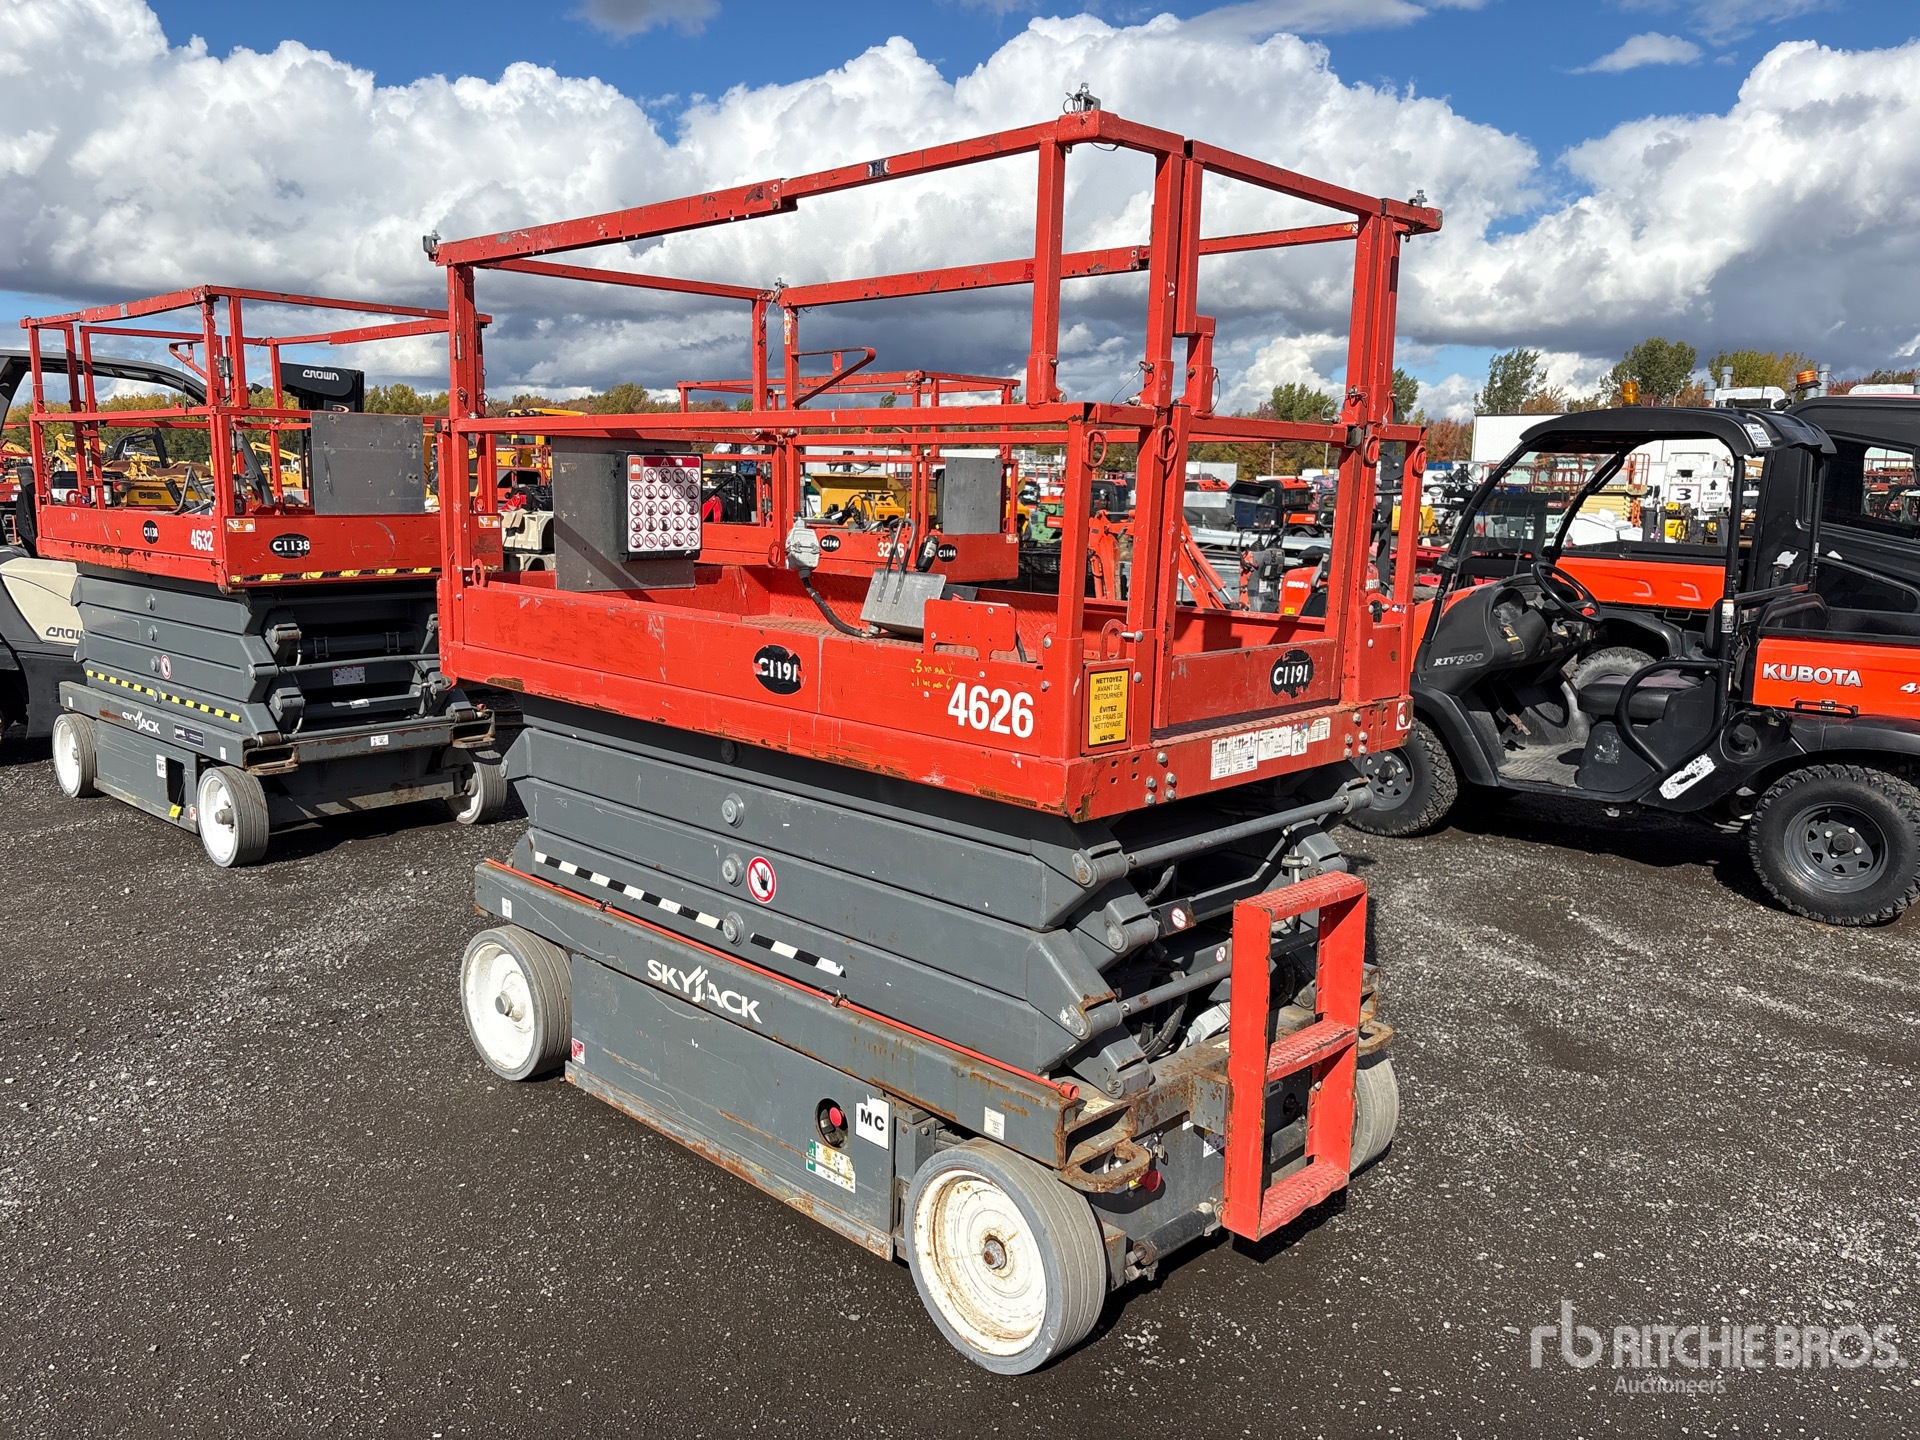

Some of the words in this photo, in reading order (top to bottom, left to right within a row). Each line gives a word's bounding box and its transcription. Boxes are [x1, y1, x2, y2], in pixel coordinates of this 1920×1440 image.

[302, 369, 339, 381] CROWN
[1676, 488, 1692, 501] 3
[190, 529, 214, 551] 4632
[877, 542, 905, 558] 326
[1433, 652, 1484, 667] RTV500
[1095, 675, 1123, 685] NETTOYEZ
[1762, 662, 1863, 688] KUBOTA
[1094, 692, 1123, 701] RETOURNER
[947, 682, 1035, 739] 4626
[1094, 720, 1122, 730] NETTOYAGE
[647, 959, 763, 1024] SKYJACK
